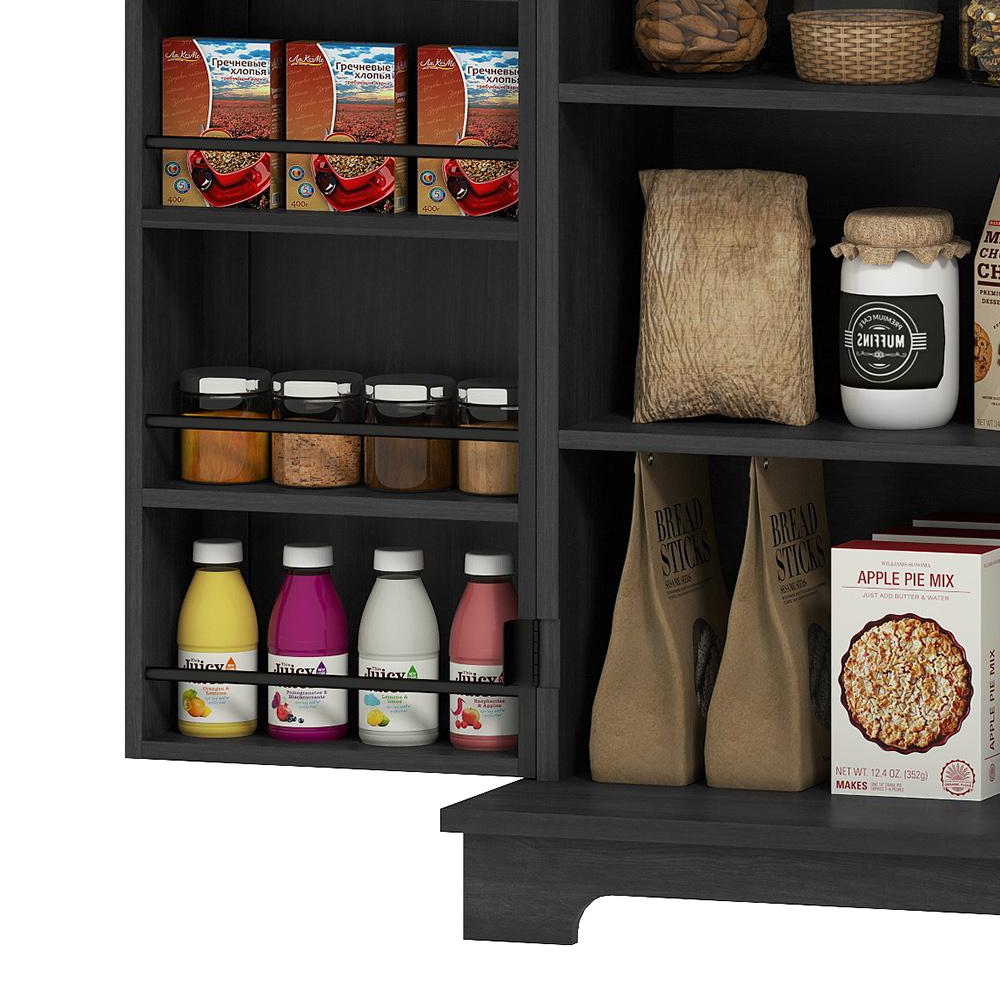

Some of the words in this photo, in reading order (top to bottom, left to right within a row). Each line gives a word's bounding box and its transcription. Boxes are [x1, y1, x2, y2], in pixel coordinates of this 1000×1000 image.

[212, 58, 267, 68] Гречневые
[335, 62, 391, 72] Гречневые
[230, 68, 267, 76] хлопья
[354, 72, 391, 80] хлопья
[654, 498, 704, 543] BREAD
[769, 502, 818, 548] BREAD
[660, 531, 711, 577] STICKS
[775, 535, 826, 582] STICKS
[858, 570, 900, 585] APPLE
[905, 572, 924, 586] PIE
[930, 573, 954, 588] MIX
[836, 766, 852, 776] NET
[871, 768, 887, 778] 12.4
[904, 770, 928, 782] (352g)
[836, 780, 868, 790] MAKES
